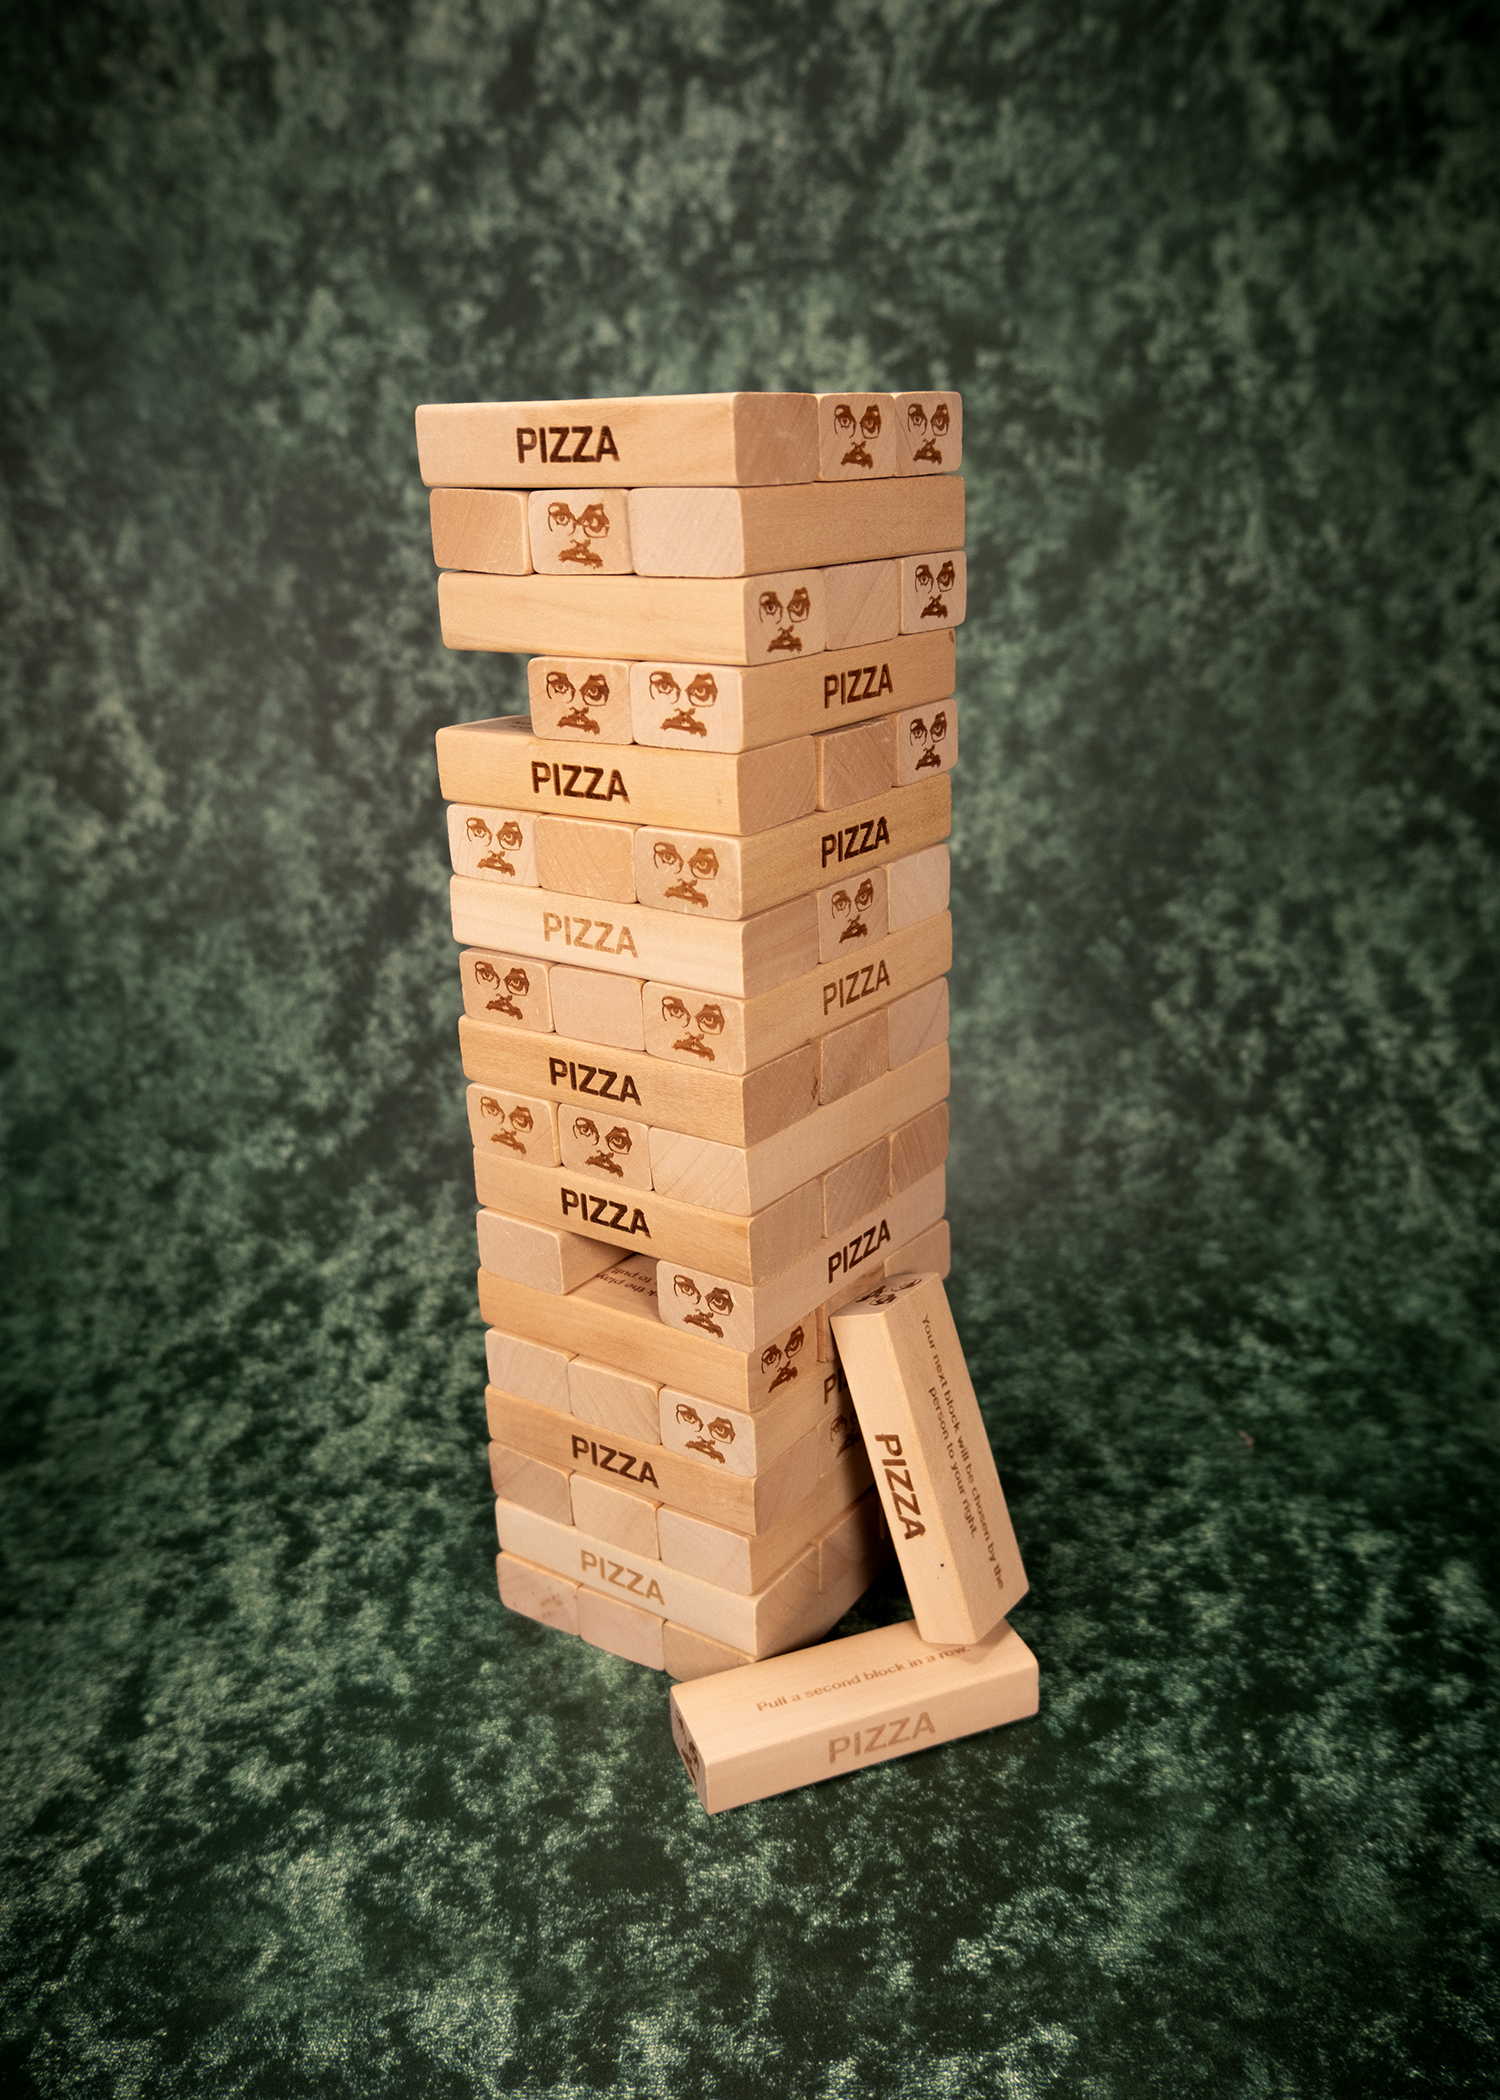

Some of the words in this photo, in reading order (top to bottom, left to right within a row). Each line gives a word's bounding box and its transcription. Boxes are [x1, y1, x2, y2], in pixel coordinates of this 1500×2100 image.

[516, 425, 620, 464] PIZZA
[823, 663, 894, 710] PIZZA
[531, 760, 630, 804] PIZZA
[821, 815, 891, 869] PIZZA
[543, 911, 639, 959] PIZZA
[822, 959, 891, 1016] PIZZA
[548, 1056, 642, 1107] PIZZA
[560, 1187, 652, 1240] PIZZA
[828, 1218, 891, 1284] PIZZA
[625, 1282, 646, 1293] the
[571, 1434, 660, 1490] PIZZA
[922, 1314, 936, 1349] Your
[933, 1354, 948, 1389] next
[944, 1389, 960, 1434] block
[957, 1436, 970, 1462] will
[965, 1463, 974, 1484] be
[971, 1487, 990, 1542] chosen
[987, 1541, 996, 1562] by
[993, 1564, 1004, 1589] the
[928, 1387, 949, 1440] person
[946, 1442, 955, 1459] to
[951, 1462, 966, 1494] your
[962, 1499, 978, 1539] right.
[874, 1433, 926, 1541] PIZZA
[580, 1548, 666, 1607] PIZZA
[755, 1696, 788, 1712] Pull
[791, 1692, 802, 1702] a
[804, 1675, 861, 1698] second
[862, 1662, 906, 1681] block
[909, 1657, 923, 1668] in
[926, 1655, 936, 1663] a
[938, 1645, 972, 1659] row.
[828, 1711, 936, 1765] PIZZA
